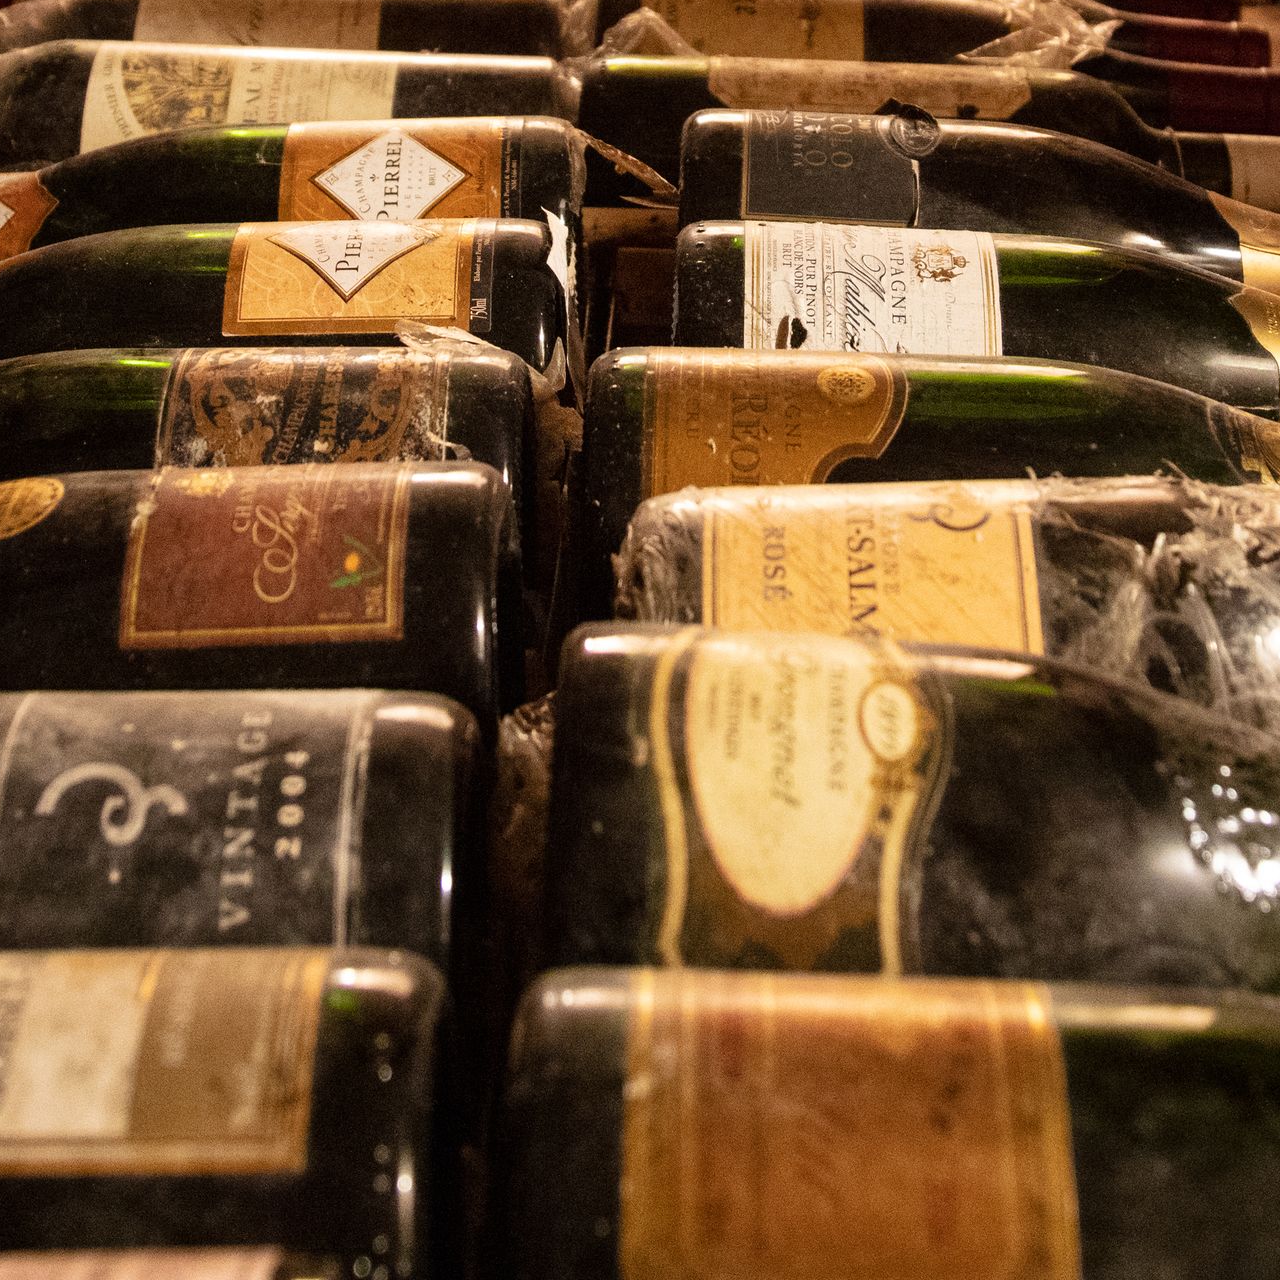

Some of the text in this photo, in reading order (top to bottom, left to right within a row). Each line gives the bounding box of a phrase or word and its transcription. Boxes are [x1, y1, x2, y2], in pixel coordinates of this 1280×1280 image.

[104, 83, 133, 138] PREMIER
[354, 145, 375, 214] CHAMPAGNE
[376, 138, 403, 220] PIERREL
[428, 165, 437, 186] BRUT
[782, 243, 793, 268] BRUT
[793, 263, 804, 295] NOIRS
[794, 251, 804, 261] DE
[806, 258, 818, 281] PUR
[470, 298, 488, 320] 750ml
[806, 284, 818, 327] PINOT
[272, 382, 314, 464] CHAMPAGNE
[314, 361, 344, 453] CHARLES
[763, 526, 792, 602] ROSÉ
[218, 709, 273, 931] VINTAGE
